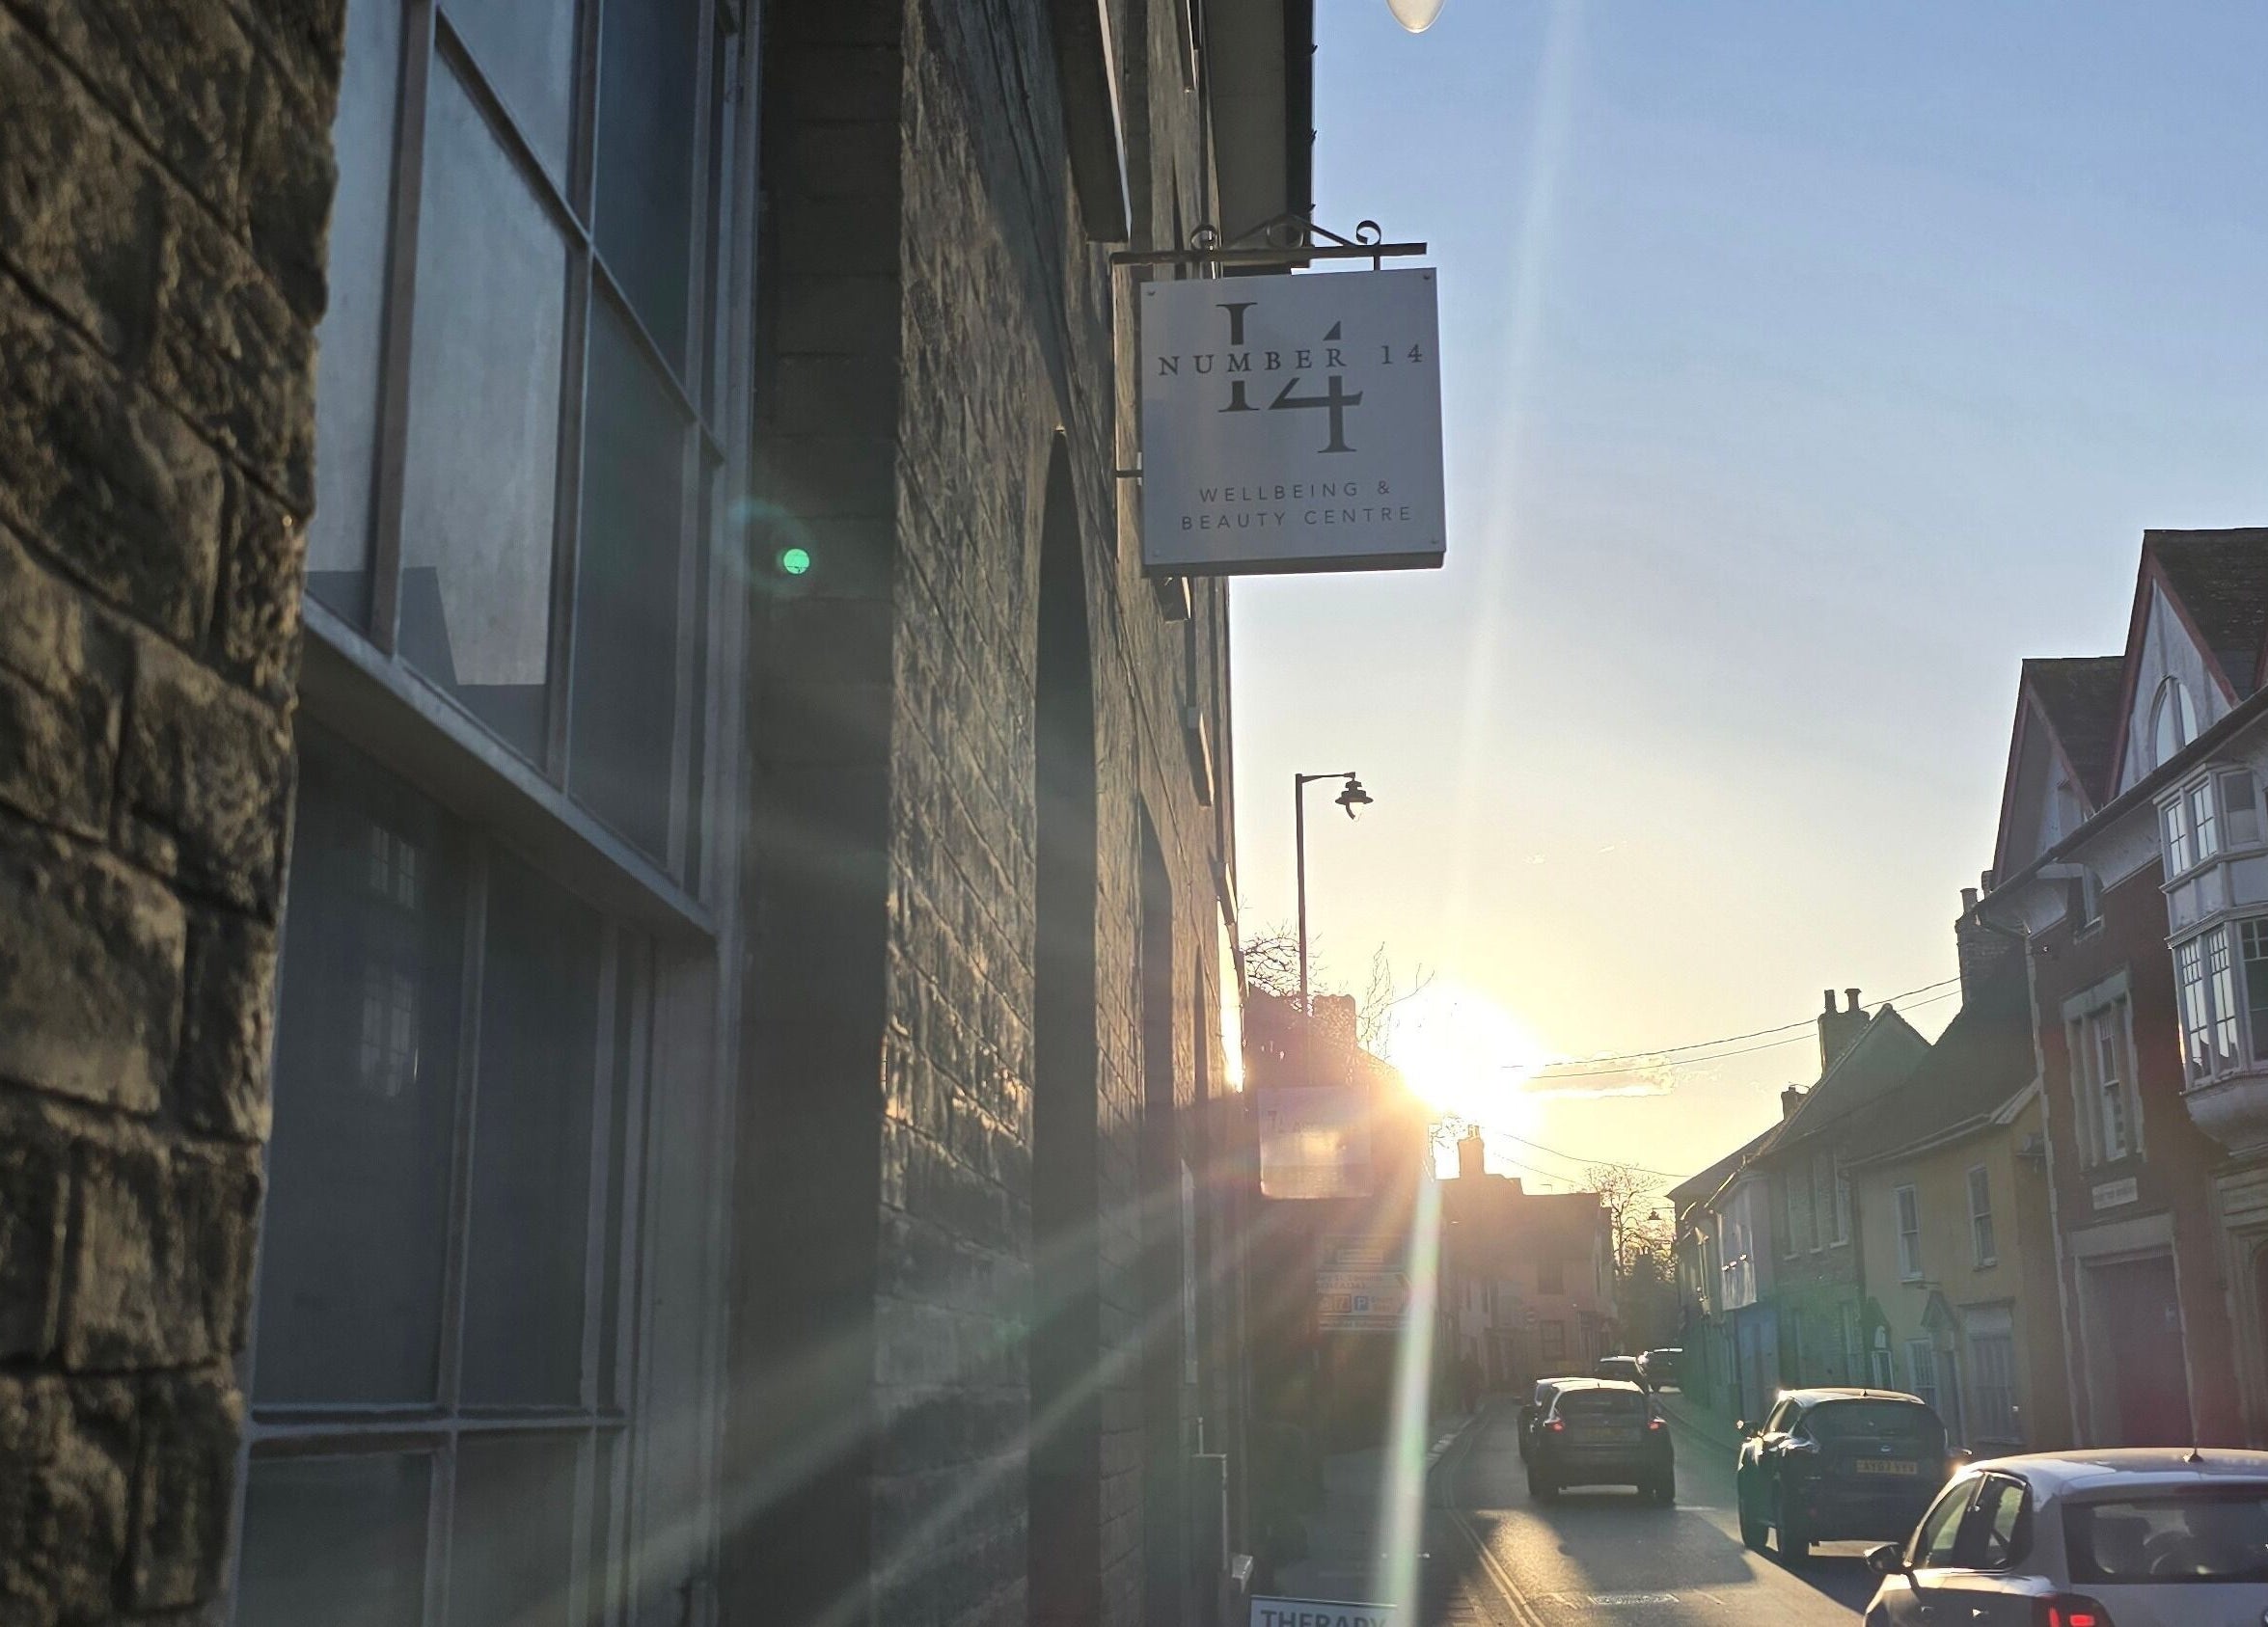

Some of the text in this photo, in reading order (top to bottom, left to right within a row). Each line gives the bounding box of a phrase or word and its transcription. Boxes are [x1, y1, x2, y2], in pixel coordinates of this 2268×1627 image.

[1159, 343, 1423, 376] NUMBER 14
[1199, 480, 1390, 503] WELLBEING &
[1181, 506, 1412, 530] BEAUTY CENTRE
